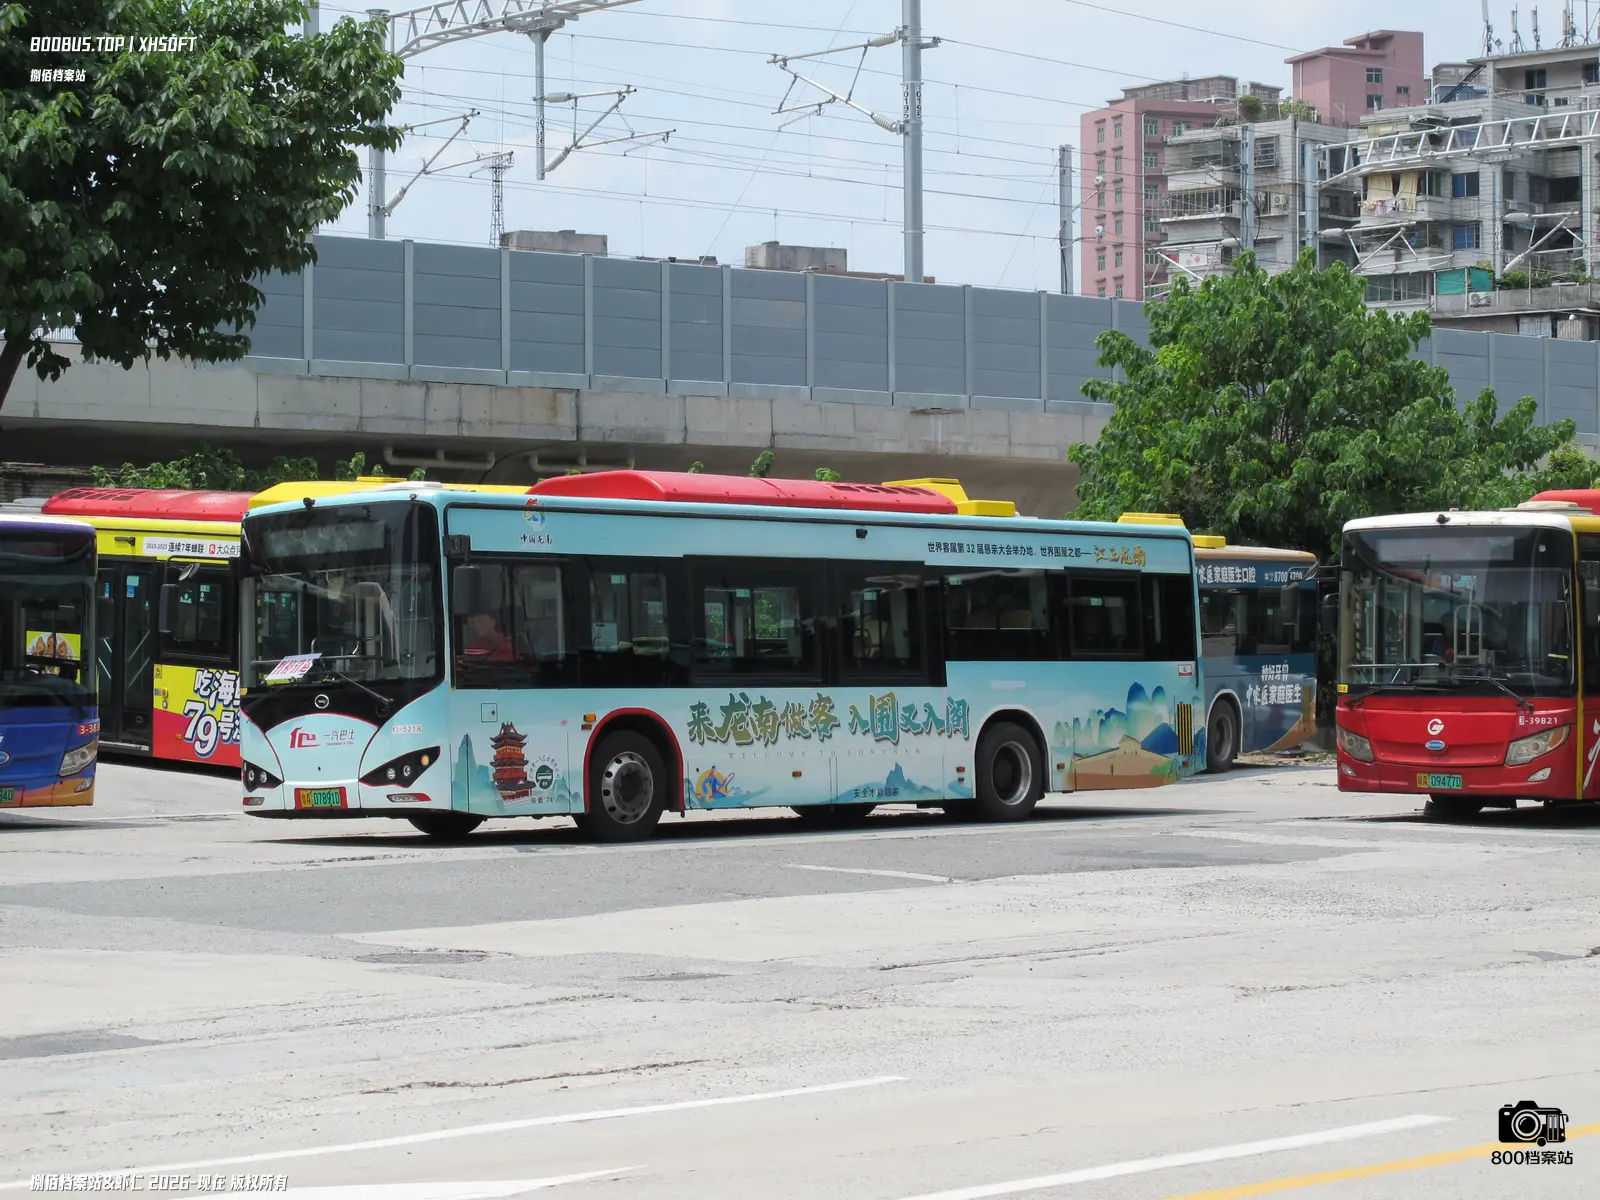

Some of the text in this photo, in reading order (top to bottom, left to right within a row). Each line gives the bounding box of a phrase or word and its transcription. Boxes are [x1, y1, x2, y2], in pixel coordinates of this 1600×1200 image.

[686, 691, 840, 748] 来龙南做客
[323, 729, 356, 741] 一汽巴士
[727, 751, 806, 760] WELCOME
